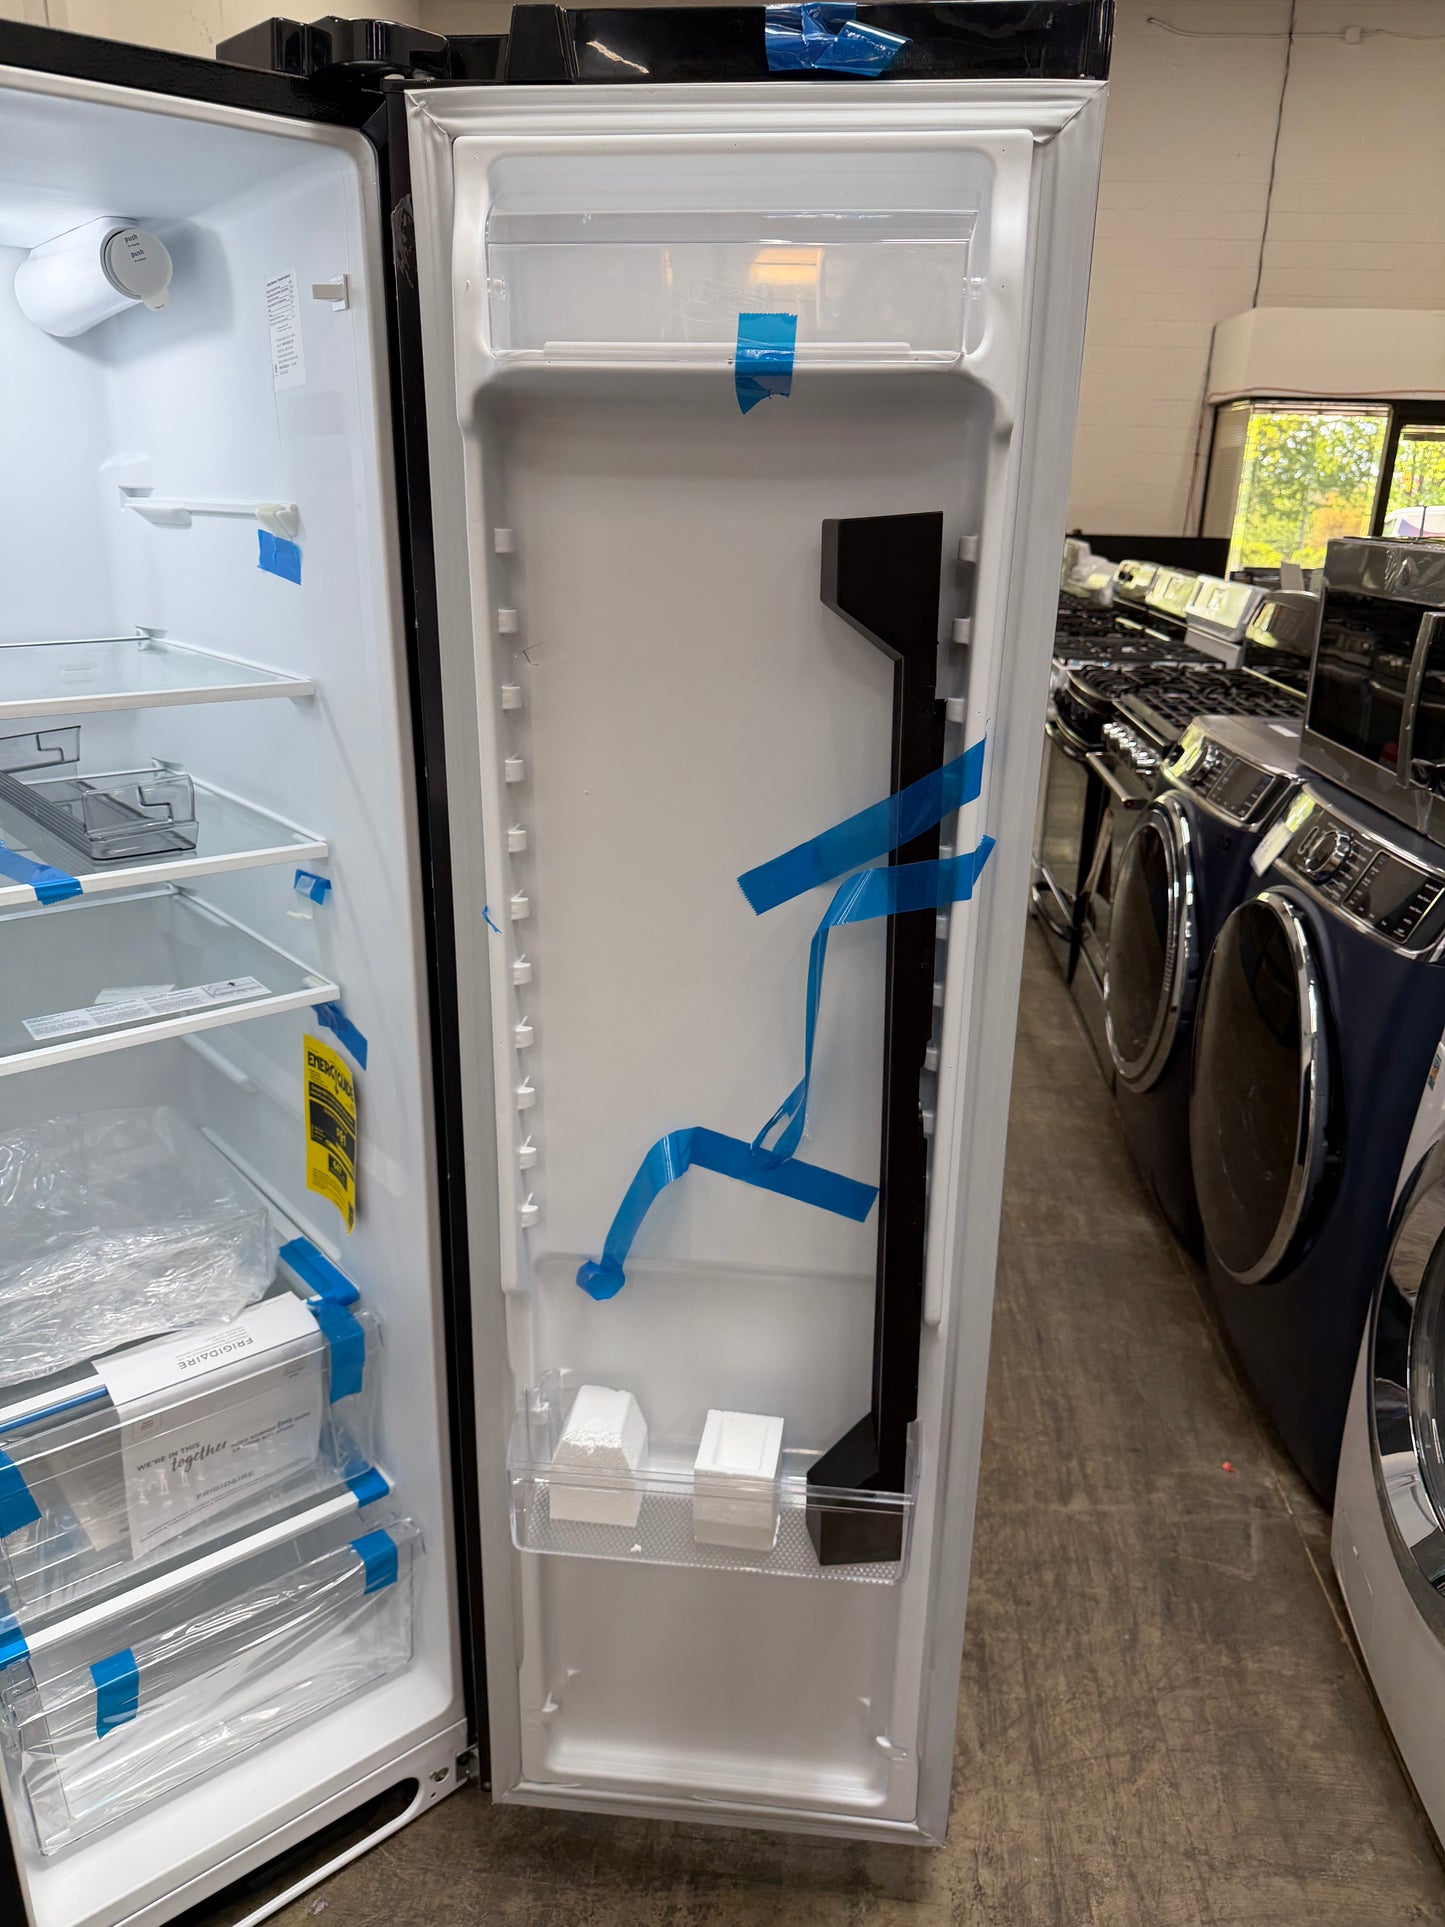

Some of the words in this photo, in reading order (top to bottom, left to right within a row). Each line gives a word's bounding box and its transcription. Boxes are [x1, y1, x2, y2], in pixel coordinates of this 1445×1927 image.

[124, 234, 138, 243] push
[131, 249, 144, 258] push
[177, 1336, 254, 1370] FRIGIDAIRE
[136, 1456, 166, 1472] WE'RE
[168, 1452, 179, 1460] IN
[179, 1441, 201, 1455] THIS
[171, 1441, 228, 1473] together
[196, 1470, 254, 1500] FRIGIDAIRE
